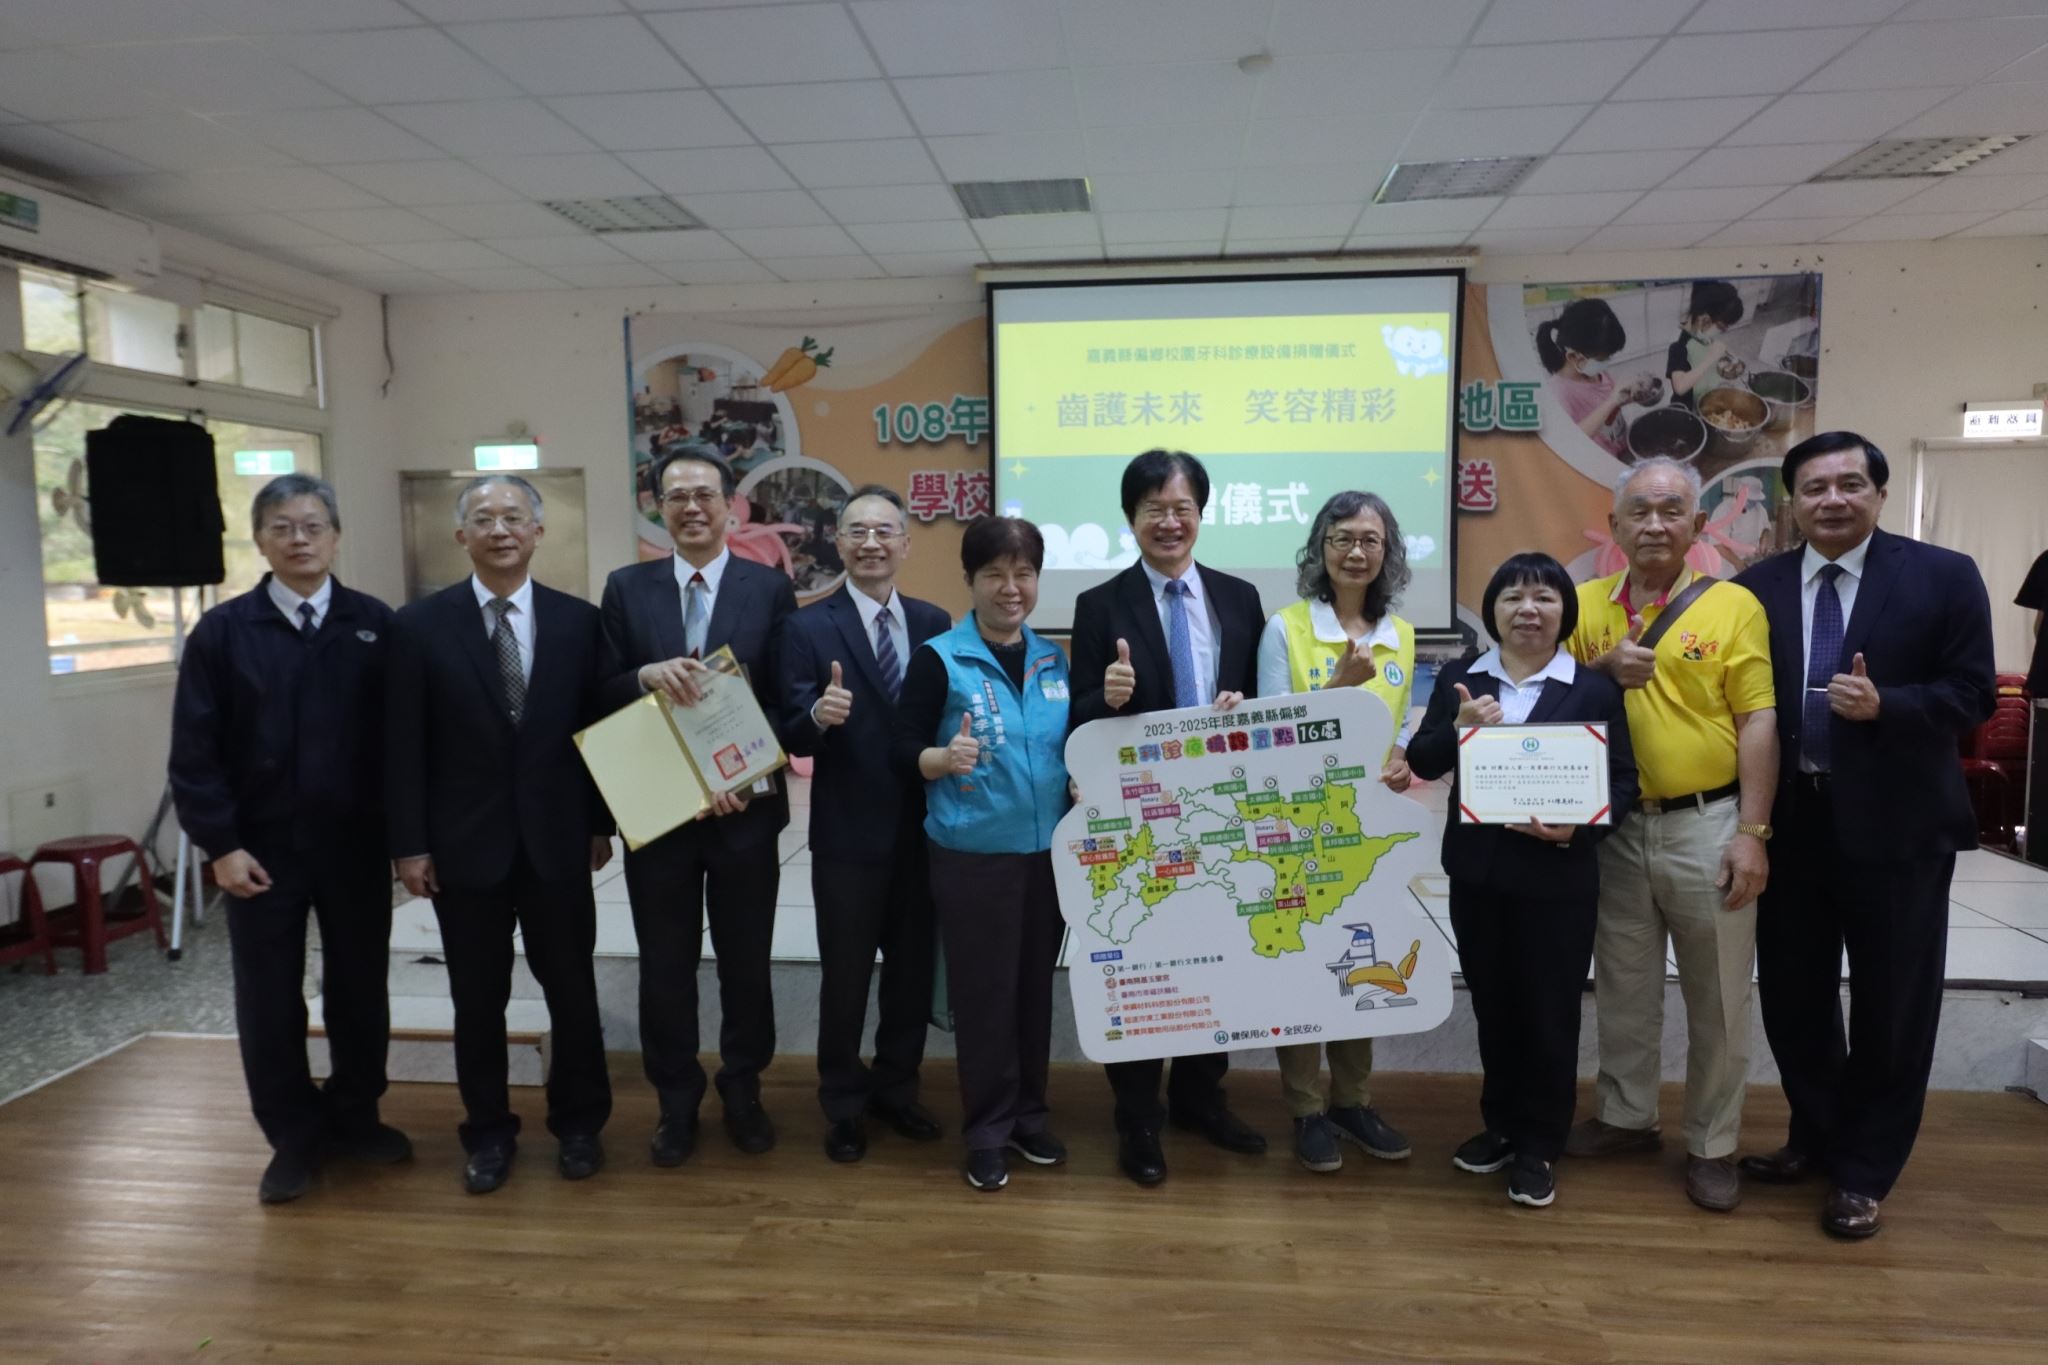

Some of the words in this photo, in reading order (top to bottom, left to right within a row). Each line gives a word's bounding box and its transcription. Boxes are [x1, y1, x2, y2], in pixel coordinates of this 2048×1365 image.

[875, 396, 989, 442] 108年
[1057, 391, 1204, 428] 齒護未來
[1244, 387, 1397, 425] 笑容精彩
[910, 472, 990, 518] 學校
[1144, 705, 1308, 737] 2023-2025年度嘉義縣偏鄉
[1231, 1029, 1269, 1041] 健保用心
[1283, 1024, 1322, 1036] 全民安心
